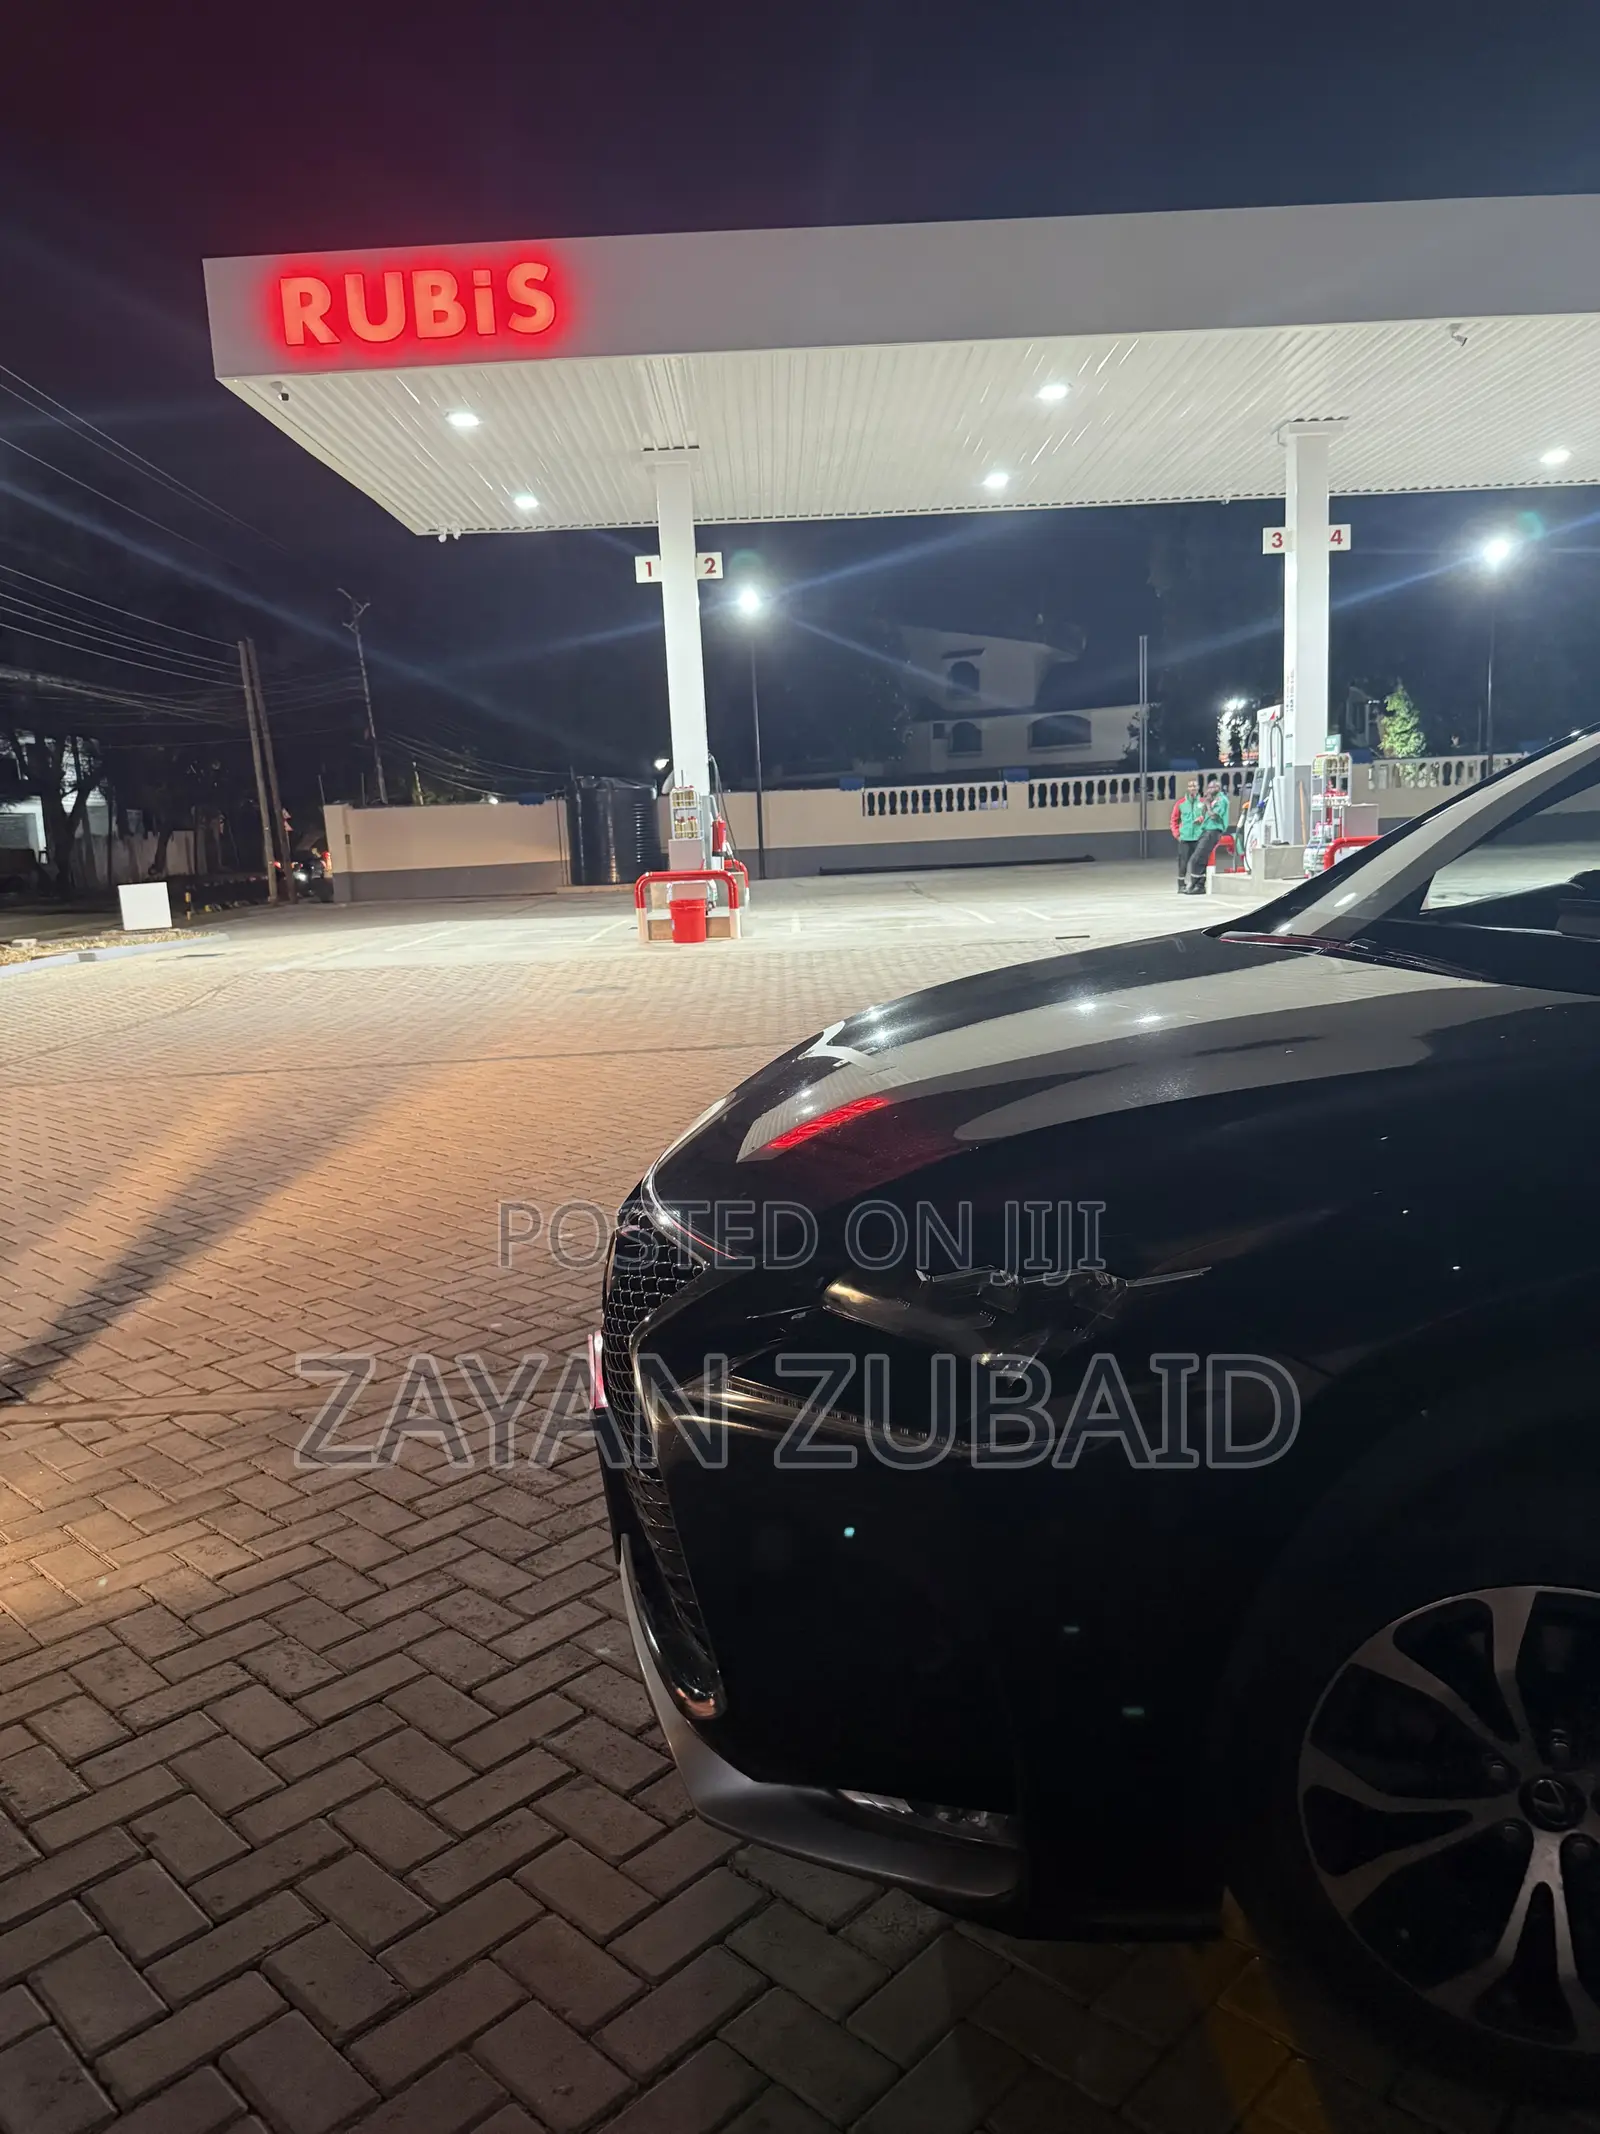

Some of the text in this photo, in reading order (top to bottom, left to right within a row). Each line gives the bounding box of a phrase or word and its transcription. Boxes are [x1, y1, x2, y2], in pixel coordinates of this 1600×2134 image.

[1271, 532, 1283, 549] 3
[1329, 529, 1343, 545] 4
[645, 561, 652, 577] 1
[703, 557, 717, 575] 2
